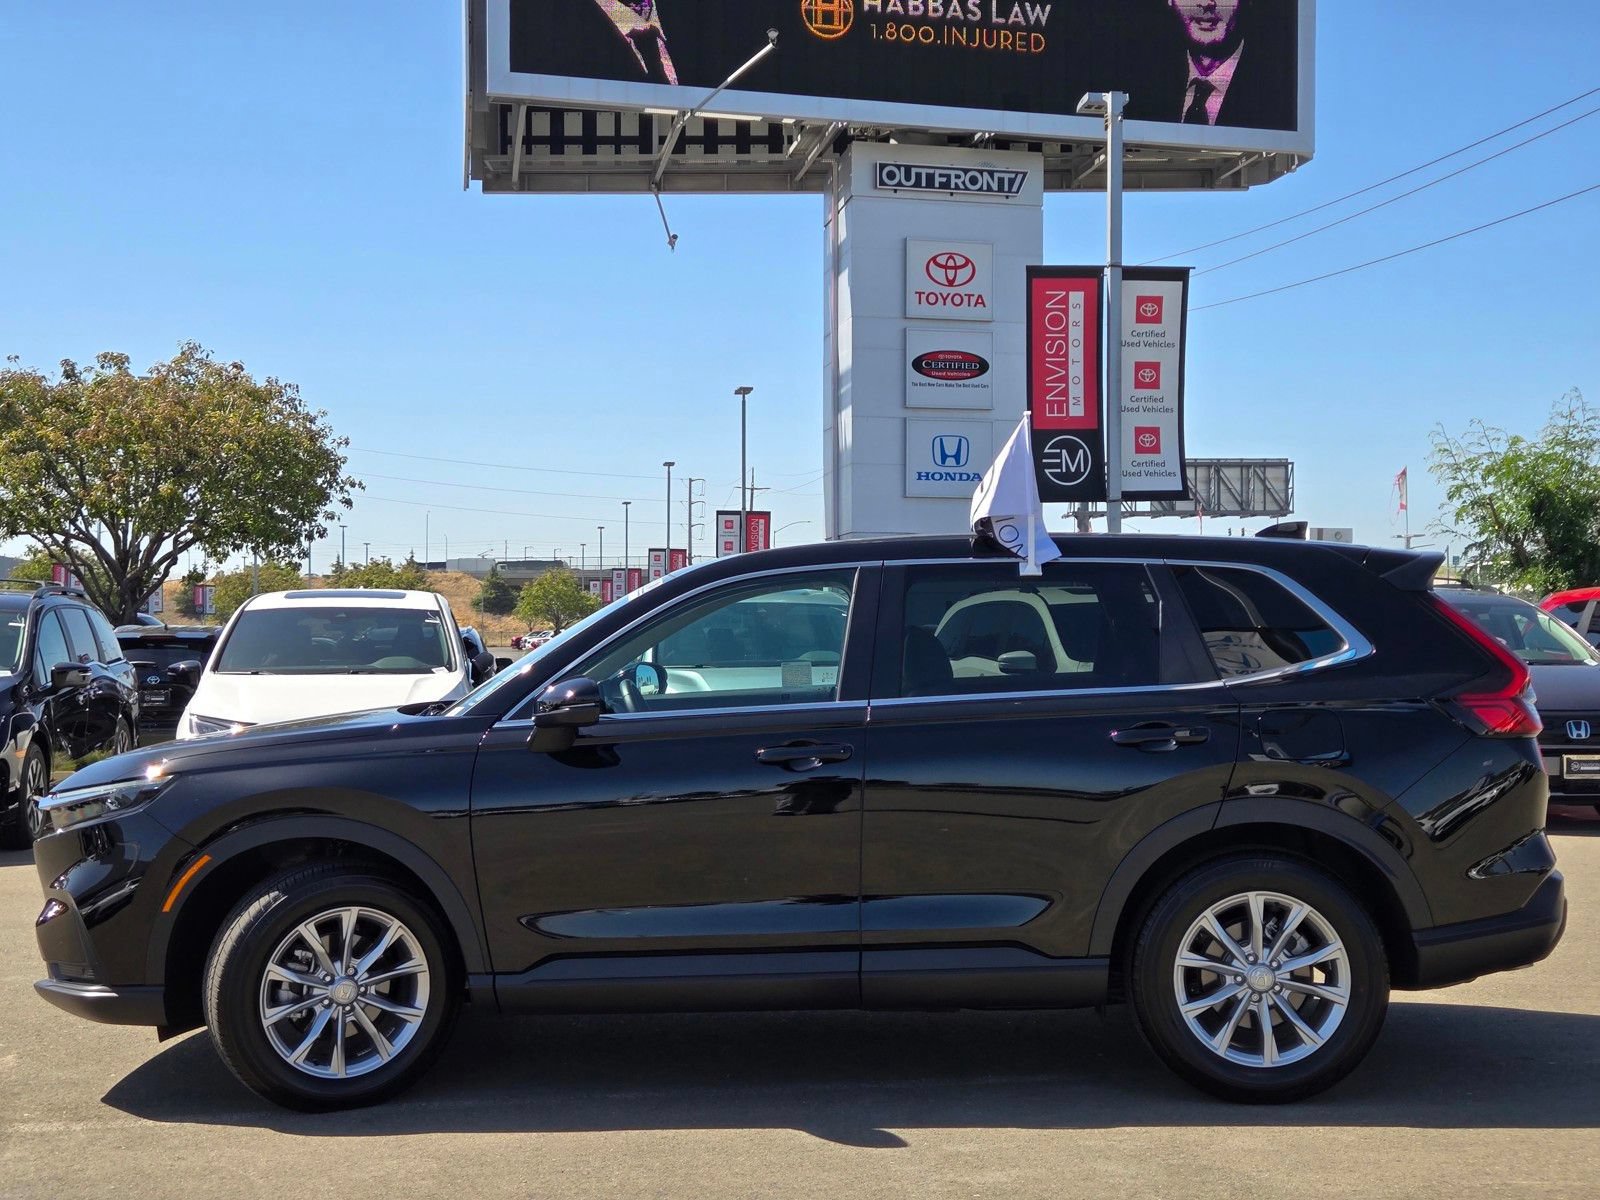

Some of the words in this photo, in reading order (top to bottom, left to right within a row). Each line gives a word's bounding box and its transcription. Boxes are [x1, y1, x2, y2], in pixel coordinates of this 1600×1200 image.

[863, 0, 982, 22] HABBAS
[991, 0, 1051, 27] LAW
[869, 21, 1046, 52] 1.800.INJURED
[914, 291, 986, 308] TOYOTA
[1130, 330, 1166, 338] Certified
[1143, 340, 1175, 348] Vehicles
[1045, 291, 1066, 416] ENVISION
[1072, 303, 1080, 406] MOTORS
[922, 360, 980, 370] CERTIFIED
[1120, 405, 1140, 413] Used
[1142, 405, 1174, 413] Vehicles
[1131, 460, 1166, 468] Certified
[916, 471, 983, 481] HONDA
